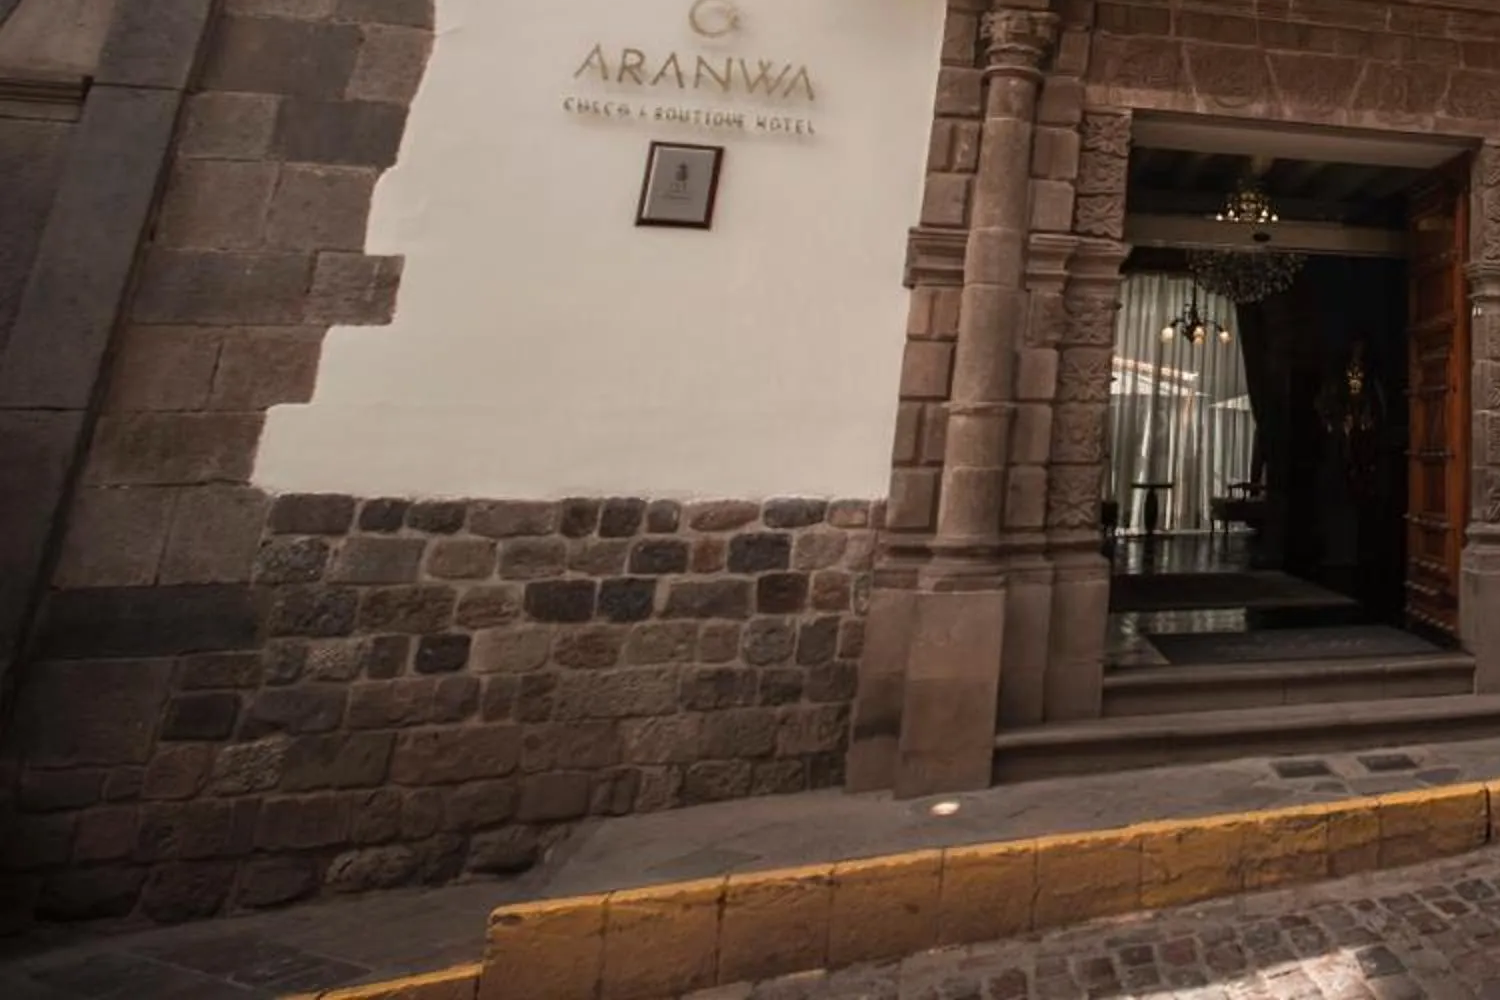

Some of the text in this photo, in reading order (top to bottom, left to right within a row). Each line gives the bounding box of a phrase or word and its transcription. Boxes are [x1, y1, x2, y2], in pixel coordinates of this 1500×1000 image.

[573, 42, 817, 102] ARANWA
[655, 105, 744, 129] BOUTIQUE
[756, 115, 816, 136] HOTEL
